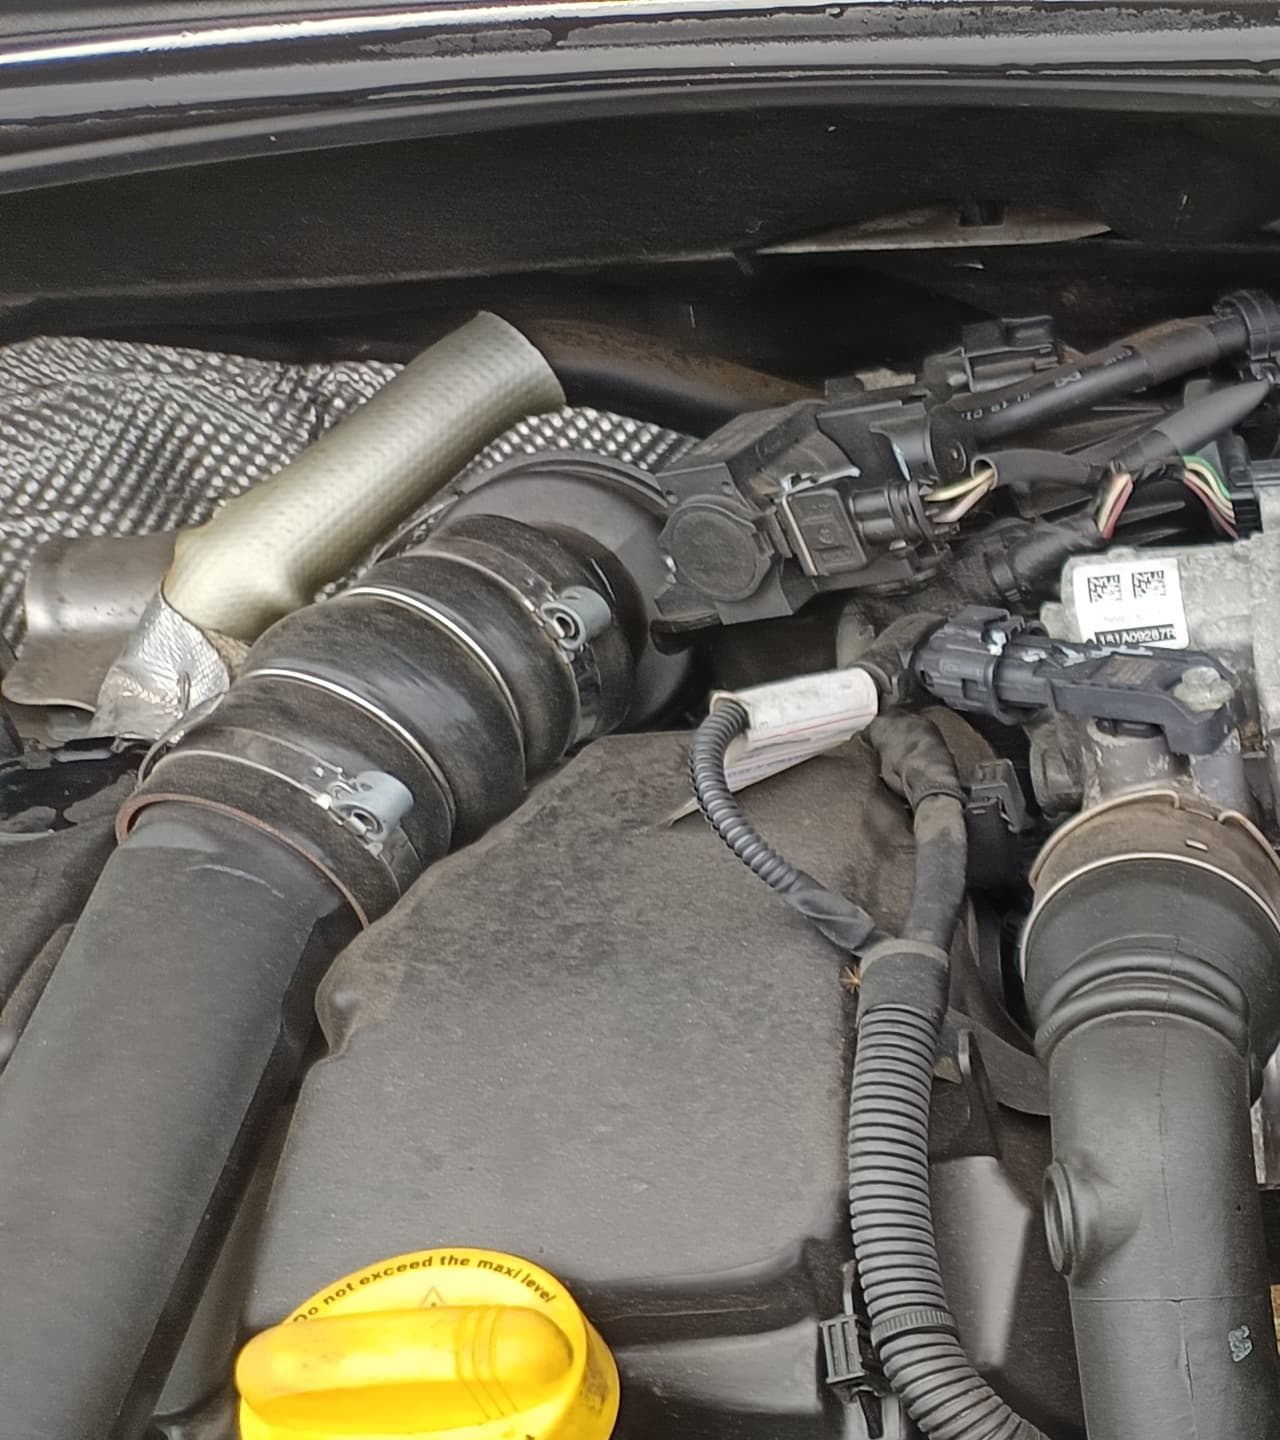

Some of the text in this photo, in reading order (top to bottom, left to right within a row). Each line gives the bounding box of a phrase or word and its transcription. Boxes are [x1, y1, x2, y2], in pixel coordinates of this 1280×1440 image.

[323, 1281, 354, 1306] not
[358, 1256, 434, 1287] exceed
[439, 1253, 471, 1267] the
[477, 1258, 521, 1279] maxi
[520, 1272, 557, 1304] level
